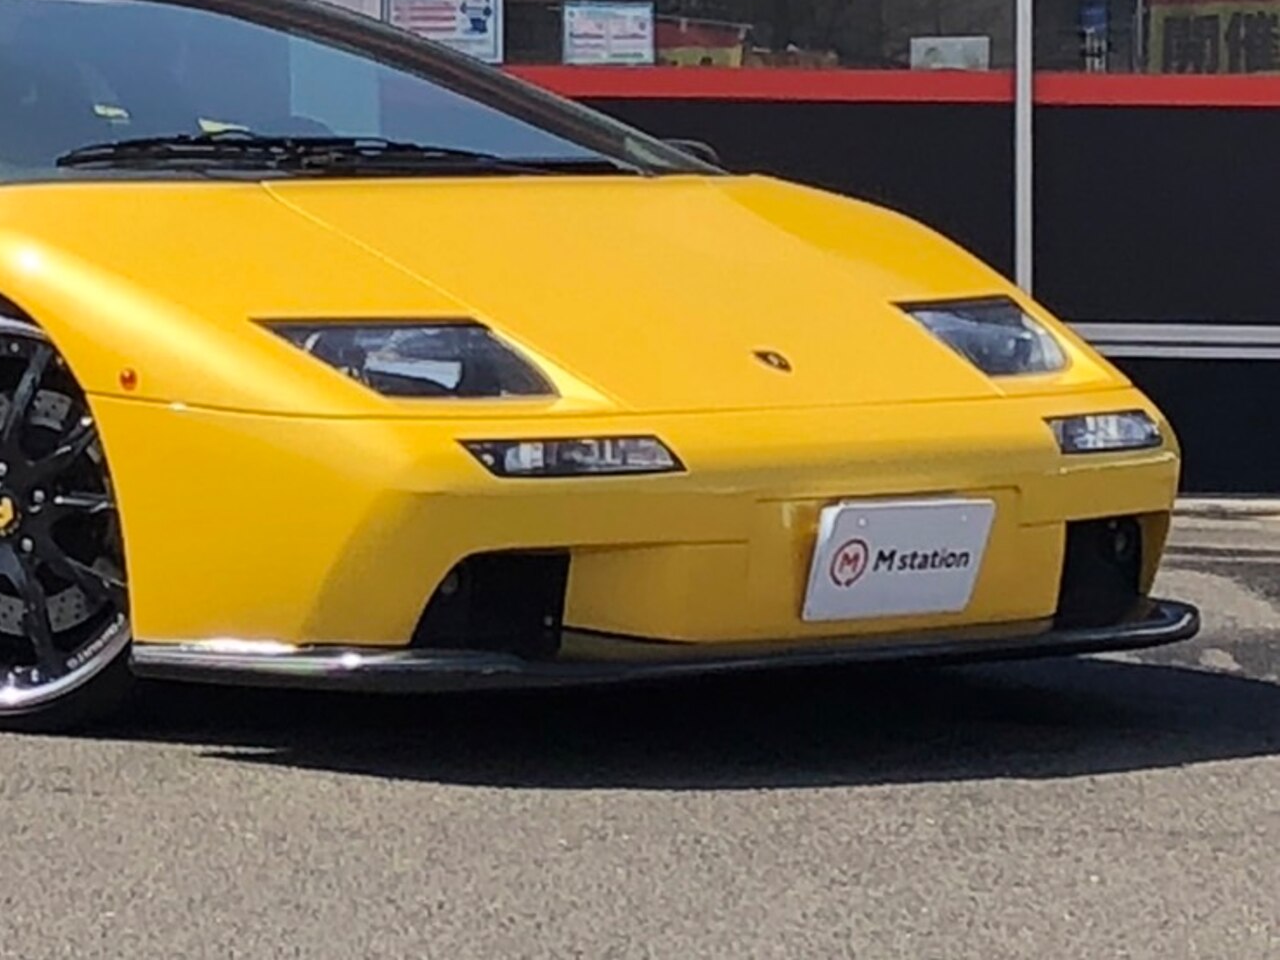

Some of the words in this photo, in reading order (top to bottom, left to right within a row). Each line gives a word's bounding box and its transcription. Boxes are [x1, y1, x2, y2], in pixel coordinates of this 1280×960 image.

[839, 552, 861, 573] M
[872, 549, 897, 572] M
[896, 547, 970, 571] station
